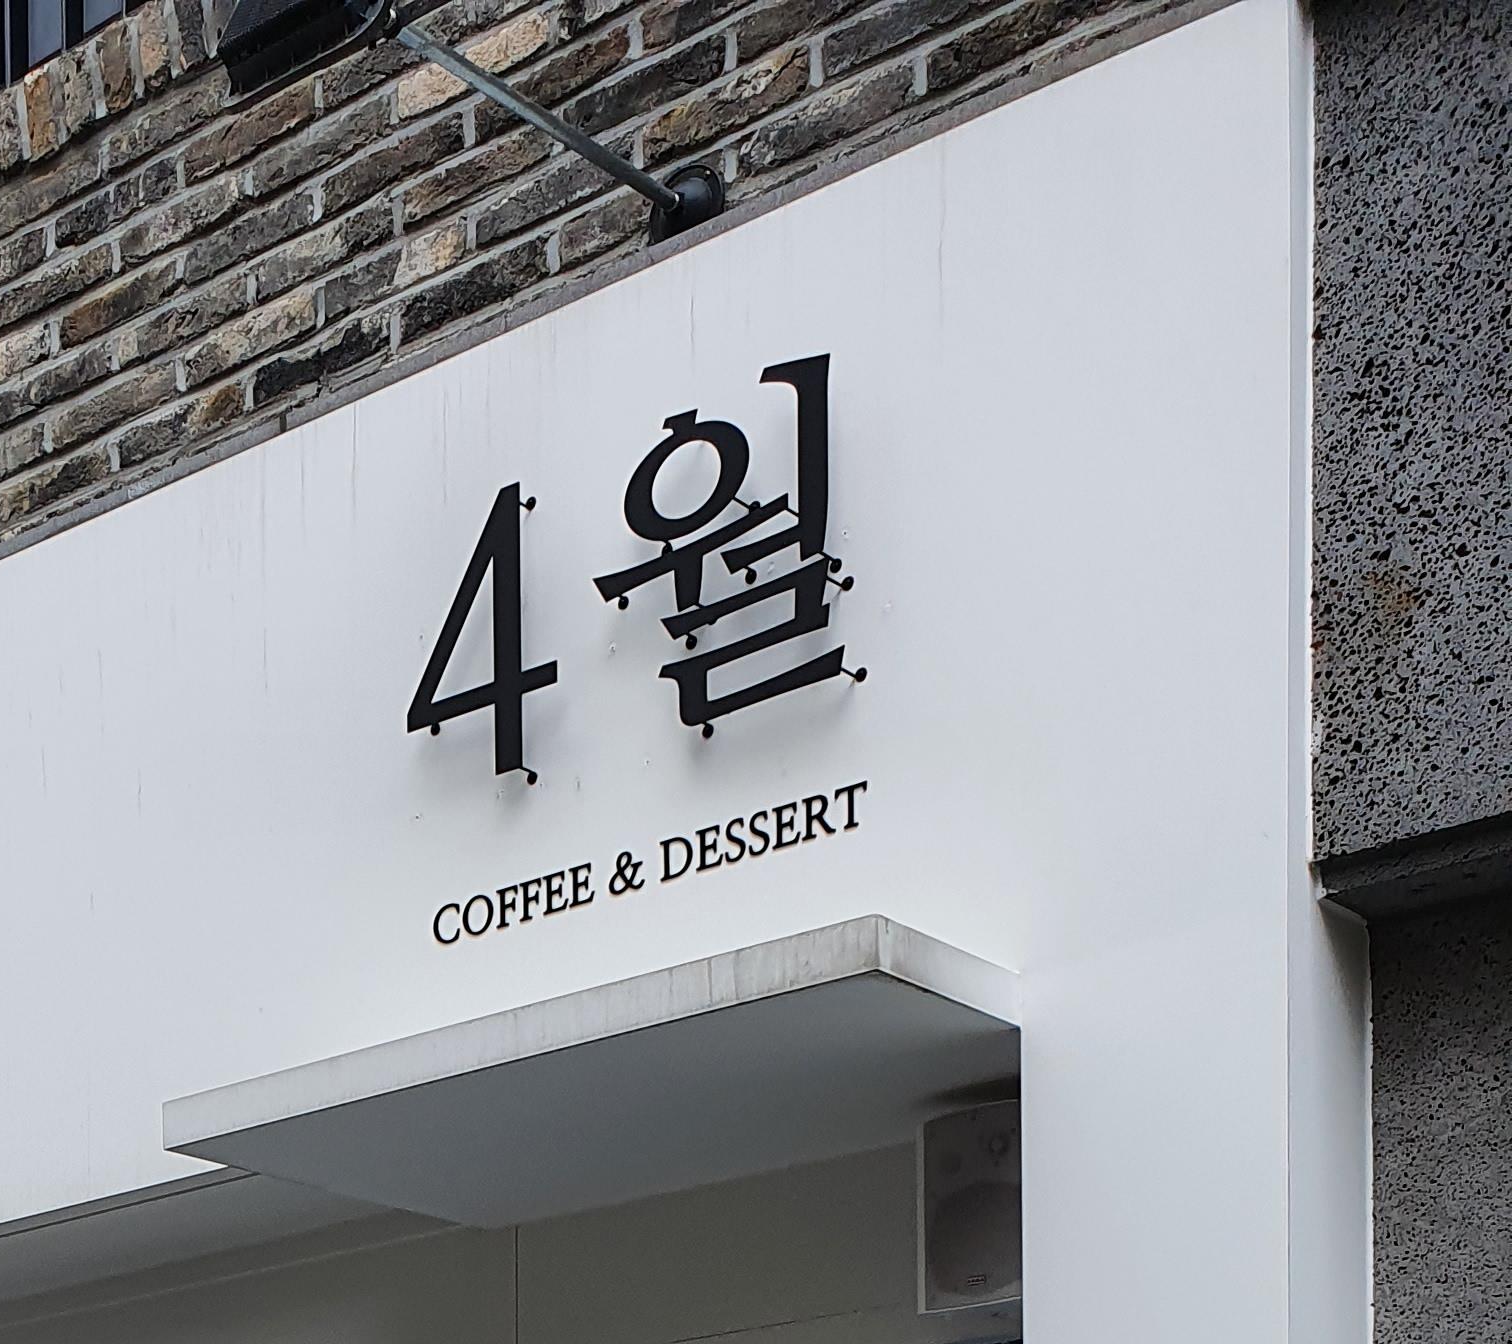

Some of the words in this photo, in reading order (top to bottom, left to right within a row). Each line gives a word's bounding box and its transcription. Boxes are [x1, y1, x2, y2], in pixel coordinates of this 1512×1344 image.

[406, 353, 853, 776] 4월
[432, 862, 595, 946] COFFEE
[608, 851, 646, 896] &
[659, 780, 868, 884] DESSERT
